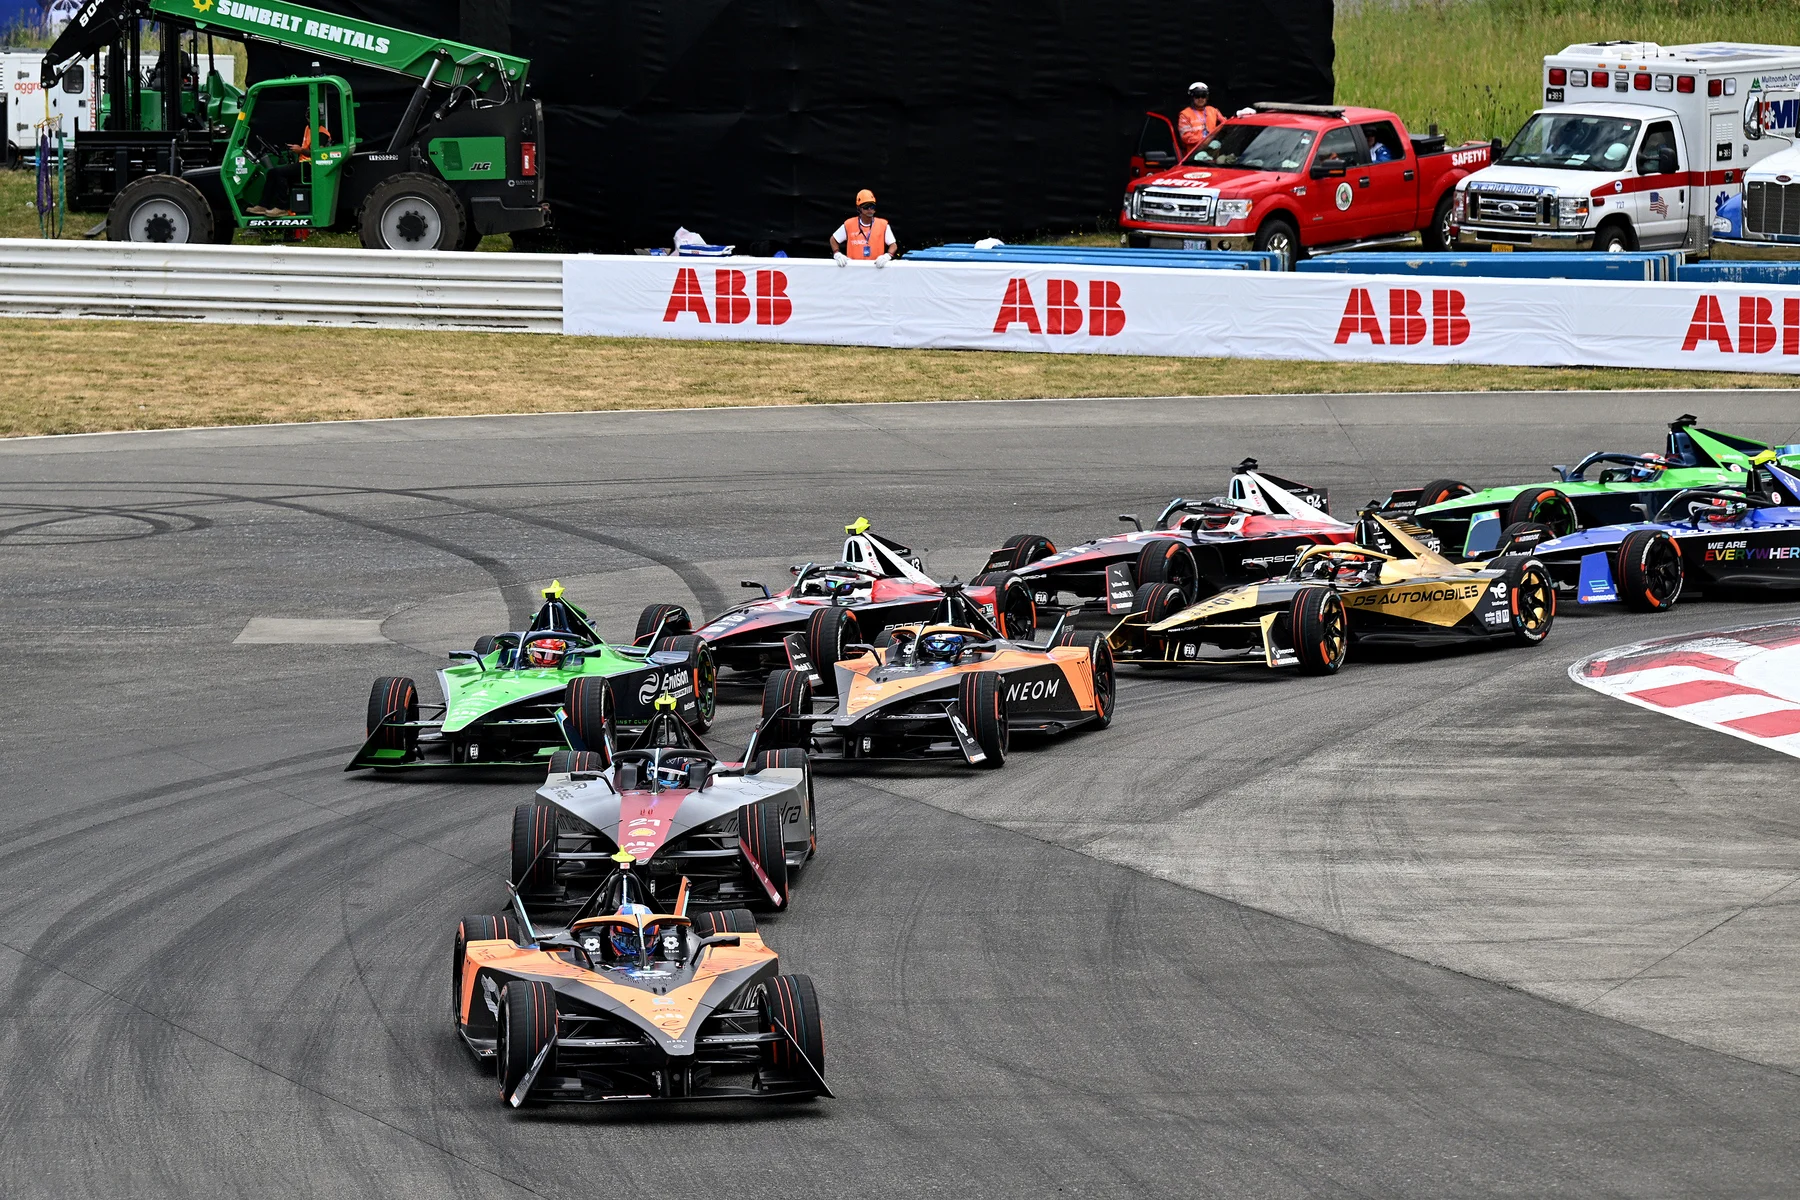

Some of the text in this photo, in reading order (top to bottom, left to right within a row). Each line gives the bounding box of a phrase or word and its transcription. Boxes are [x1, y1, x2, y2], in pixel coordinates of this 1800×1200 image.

[217, 0, 391, 54] SUNBELT RENTALS
[14, 82, 42, 94] aggre
[470, 162, 491, 171] JLG
[249, 219, 309, 227] SKYTRAK
[663, 267, 793, 326] ABB
[992, 277, 1127, 337] ABB
[1334, 288, 1472, 346] ABB
[1427, 540, 1441, 554] 25
[1708, 540, 1748, 550] WE ARE
[1353, 585, 1479, 606] DS AUTOMOBILES
[1006, 678, 1060, 702] NEOM
